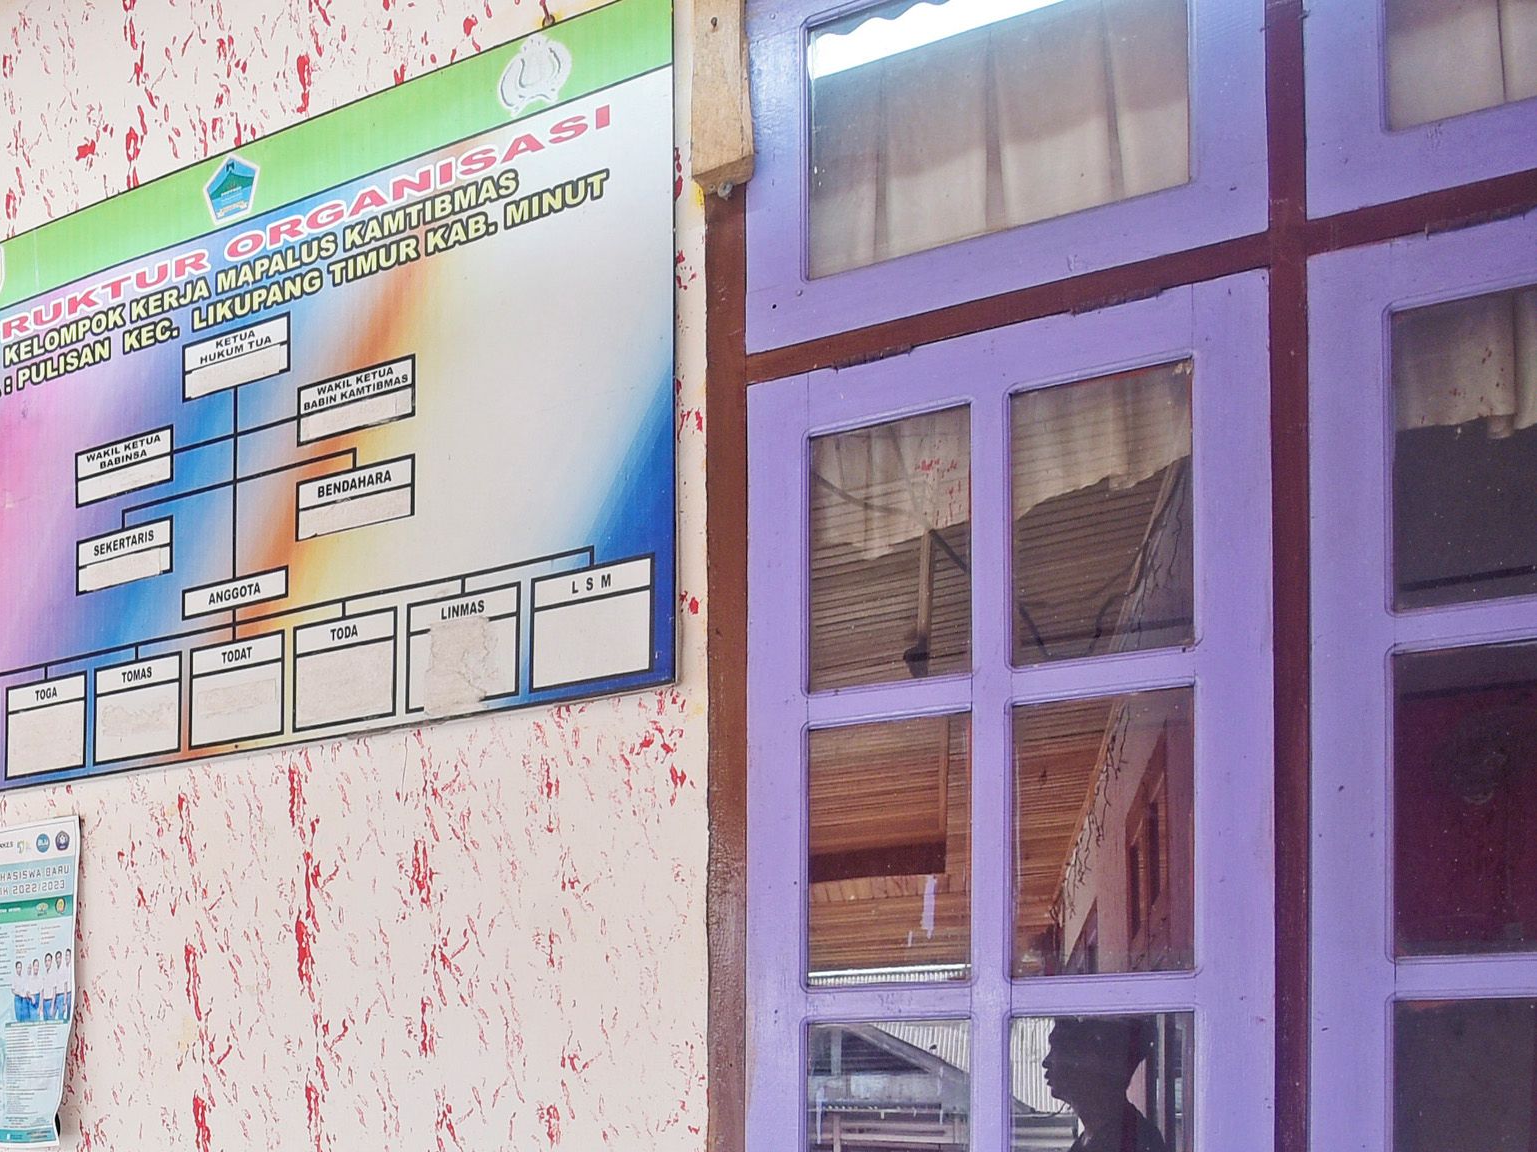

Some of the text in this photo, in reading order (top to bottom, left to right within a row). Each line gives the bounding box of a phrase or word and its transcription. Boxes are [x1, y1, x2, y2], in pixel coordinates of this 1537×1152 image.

[225, 103, 612, 260] ORGANISASI
[4, 169, 519, 367] KELOMPOK KERJA MAPALUS KAMTIBMAS
[18, 338, 111, 390] PULISAN
[123, 318, 179, 354] KEC.
[192, 270, 322, 332] LIKUPANG
[329, 237, 418, 287] TIMUR
[426, 212, 497, 254] KAB.
[504, 170, 610, 228] MINUT
[200, 336, 272, 364] HUKUM TUA
[215, 330, 255, 348] KETUA
[303, 374, 408, 411] BABIN KAMTIBMAS
[317, 367, 393, 395] WAKIL KETUA
[86, 434, 161, 463] WAKIL KETUA
[99, 450, 147, 469] BABINSA
[317, 470, 392, 498] BENDAHARA
[93, 530, 155, 557] SEKERTARIS
[208, 582, 261, 605] ANGGOTA
[441, 600, 485, 620] LINMAS
[330, 624, 358, 641] TODA
[221, 646, 253, 664] TODAT
[121, 666, 152, 683] TOMAS
[35, 687, 58, 702] TOGA
[46, 865, 69, 877] BARU
[12, 880, 65, 894] 2022/2023
